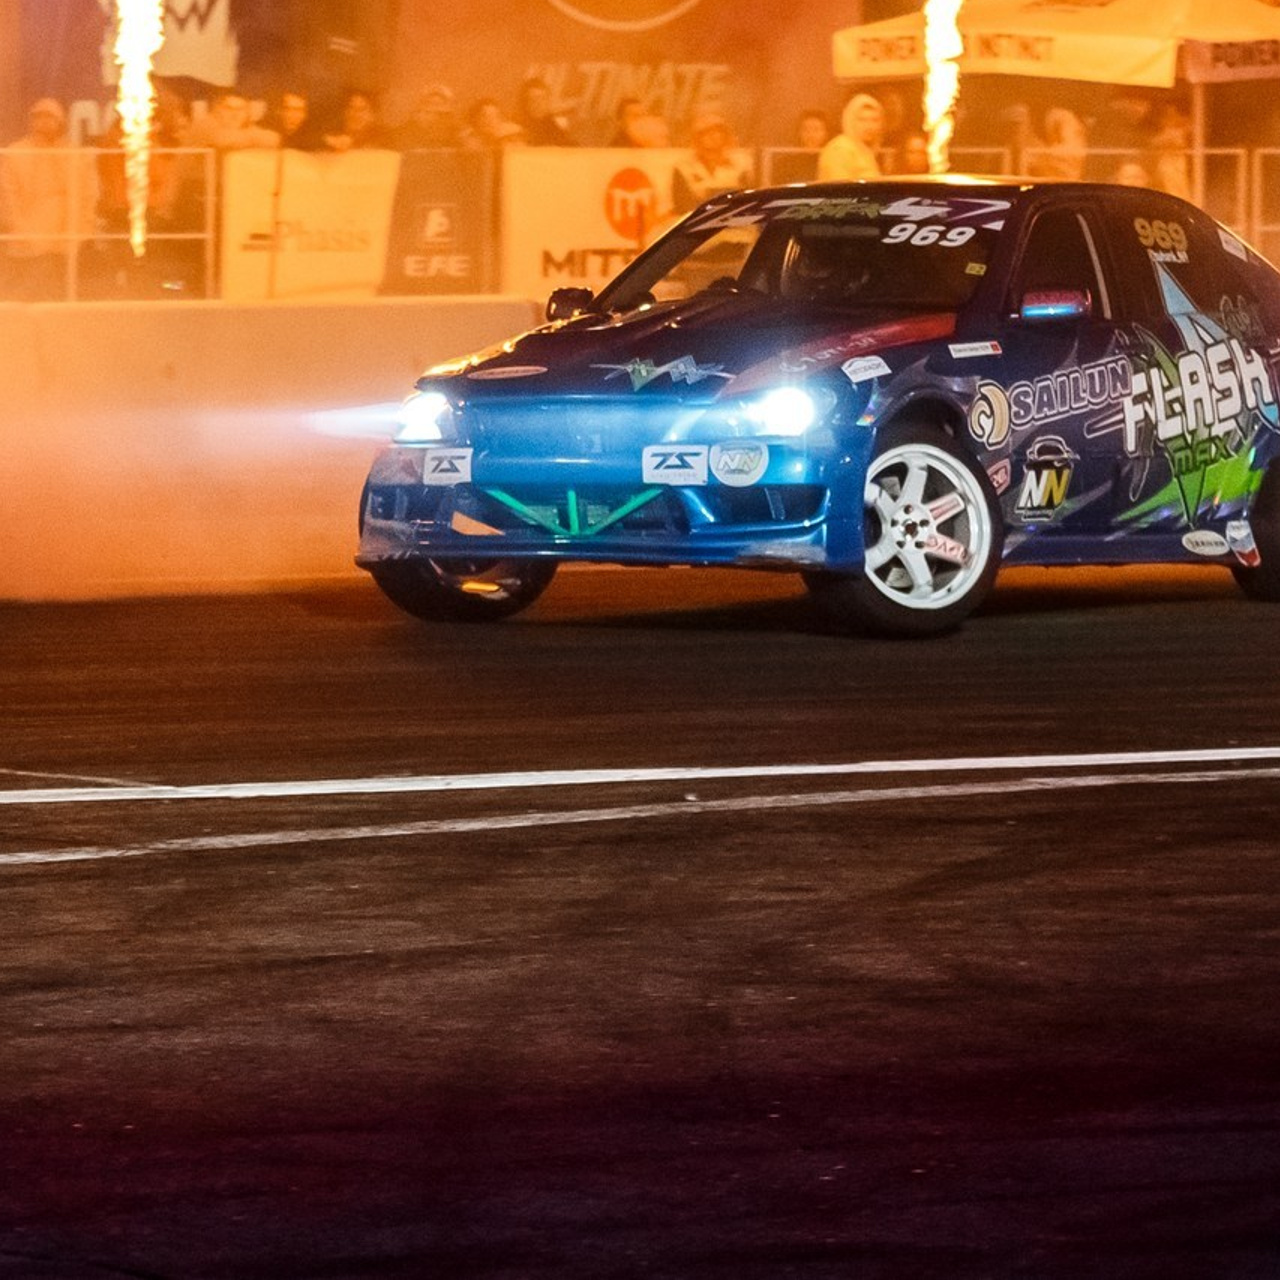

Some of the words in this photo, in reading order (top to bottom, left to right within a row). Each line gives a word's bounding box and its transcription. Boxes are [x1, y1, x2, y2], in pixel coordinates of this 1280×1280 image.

[881, 222, 976, 248] 969
[1134, 218, 1188, 251] 969
[542, 248, 641, 277] MIT
[1010, 356, 1133, 424] SAILUN
[1123, 338, 1273, 453] FLASH
